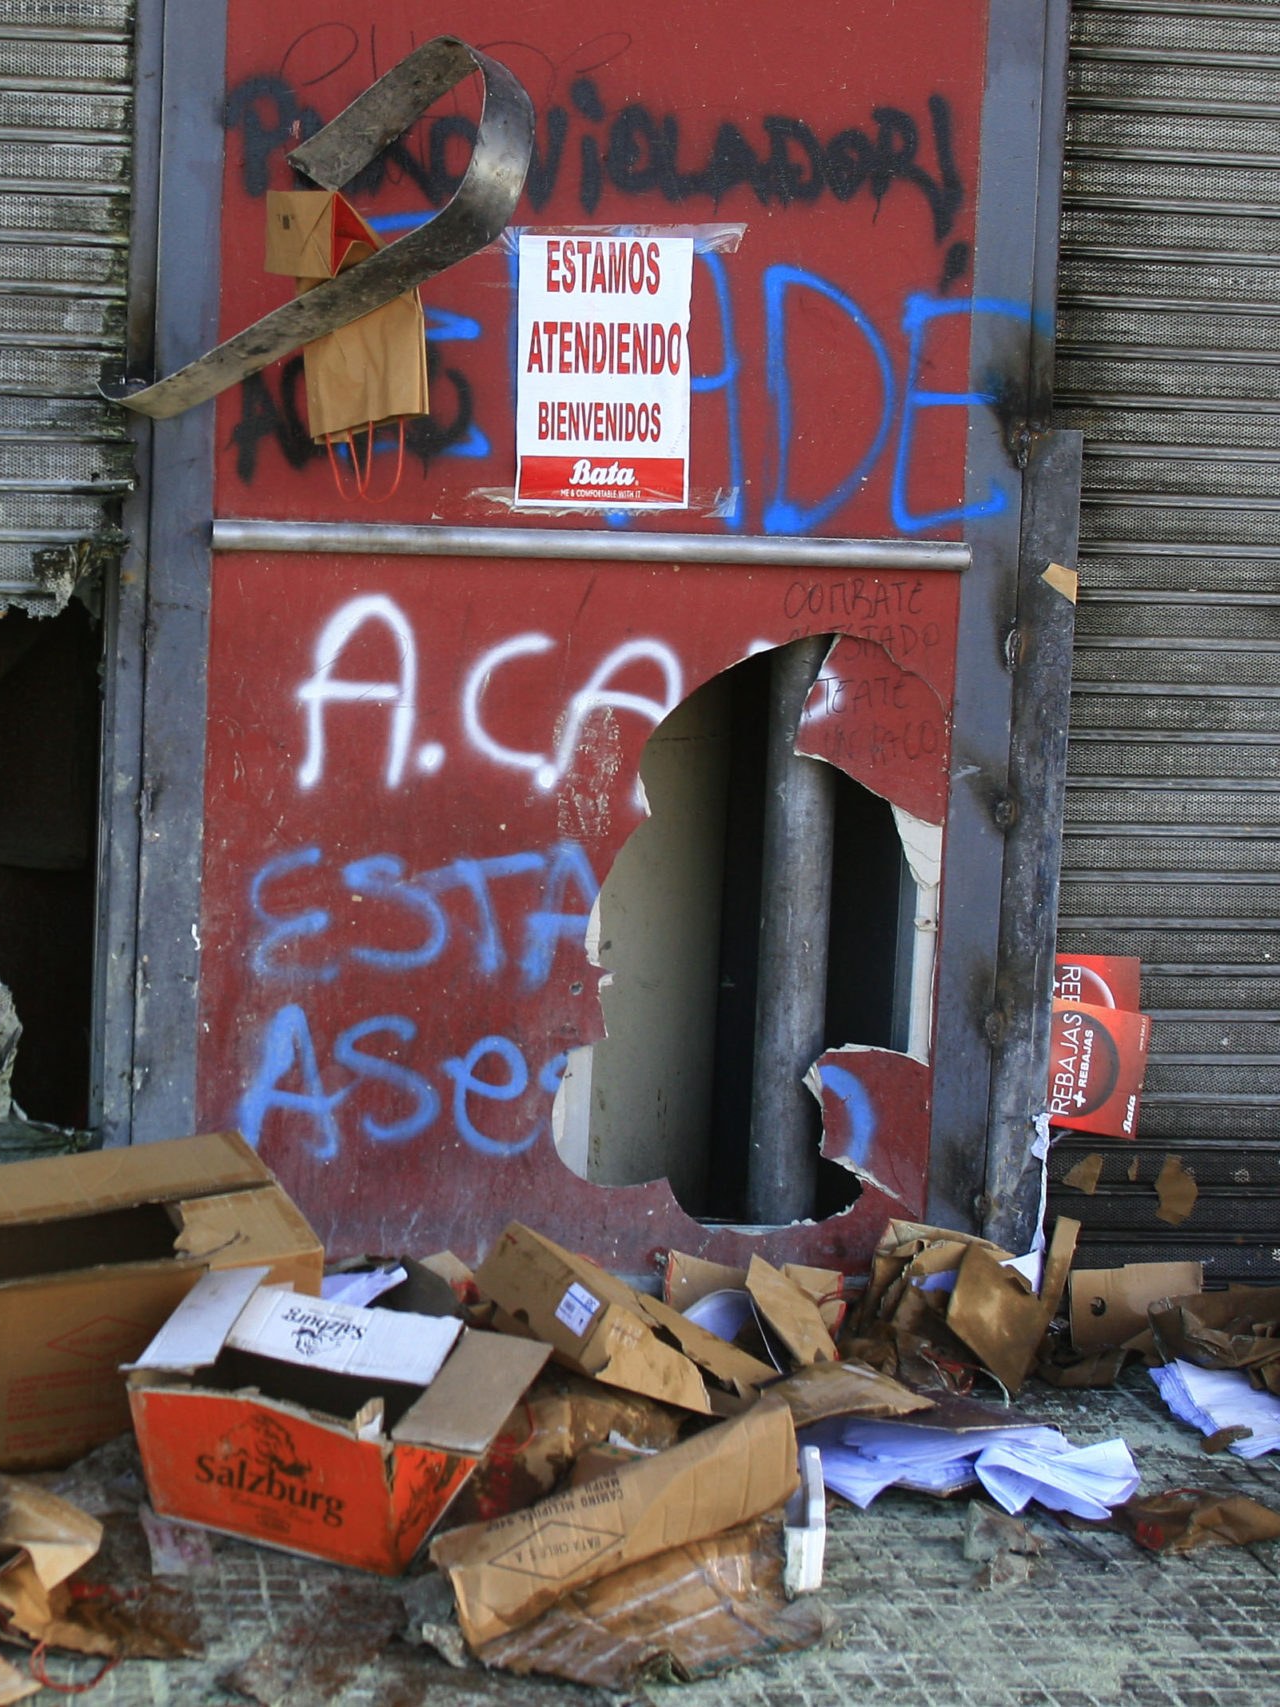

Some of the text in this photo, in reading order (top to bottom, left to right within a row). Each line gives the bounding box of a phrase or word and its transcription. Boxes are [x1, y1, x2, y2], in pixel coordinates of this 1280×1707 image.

[546, 240, 661, 295] ESTAMOS
[526, 320, 682, 376] ATENDIENDO
[537, 401, 662, 443] BIENVENIDOS
[568, 458, 635, 486] Bata
[1051, 1012, 1083, 1116] REBAJAS
[1078, 1029, 1094, 1088] REBAJAS
[1122, 1094, 1137, 1134] Bata
[282, 1306, 367, 1340] Salzburg
[195, 1453, 344, 1528] Salzburg
[580, 1488, 624, 1508] CAMINO
